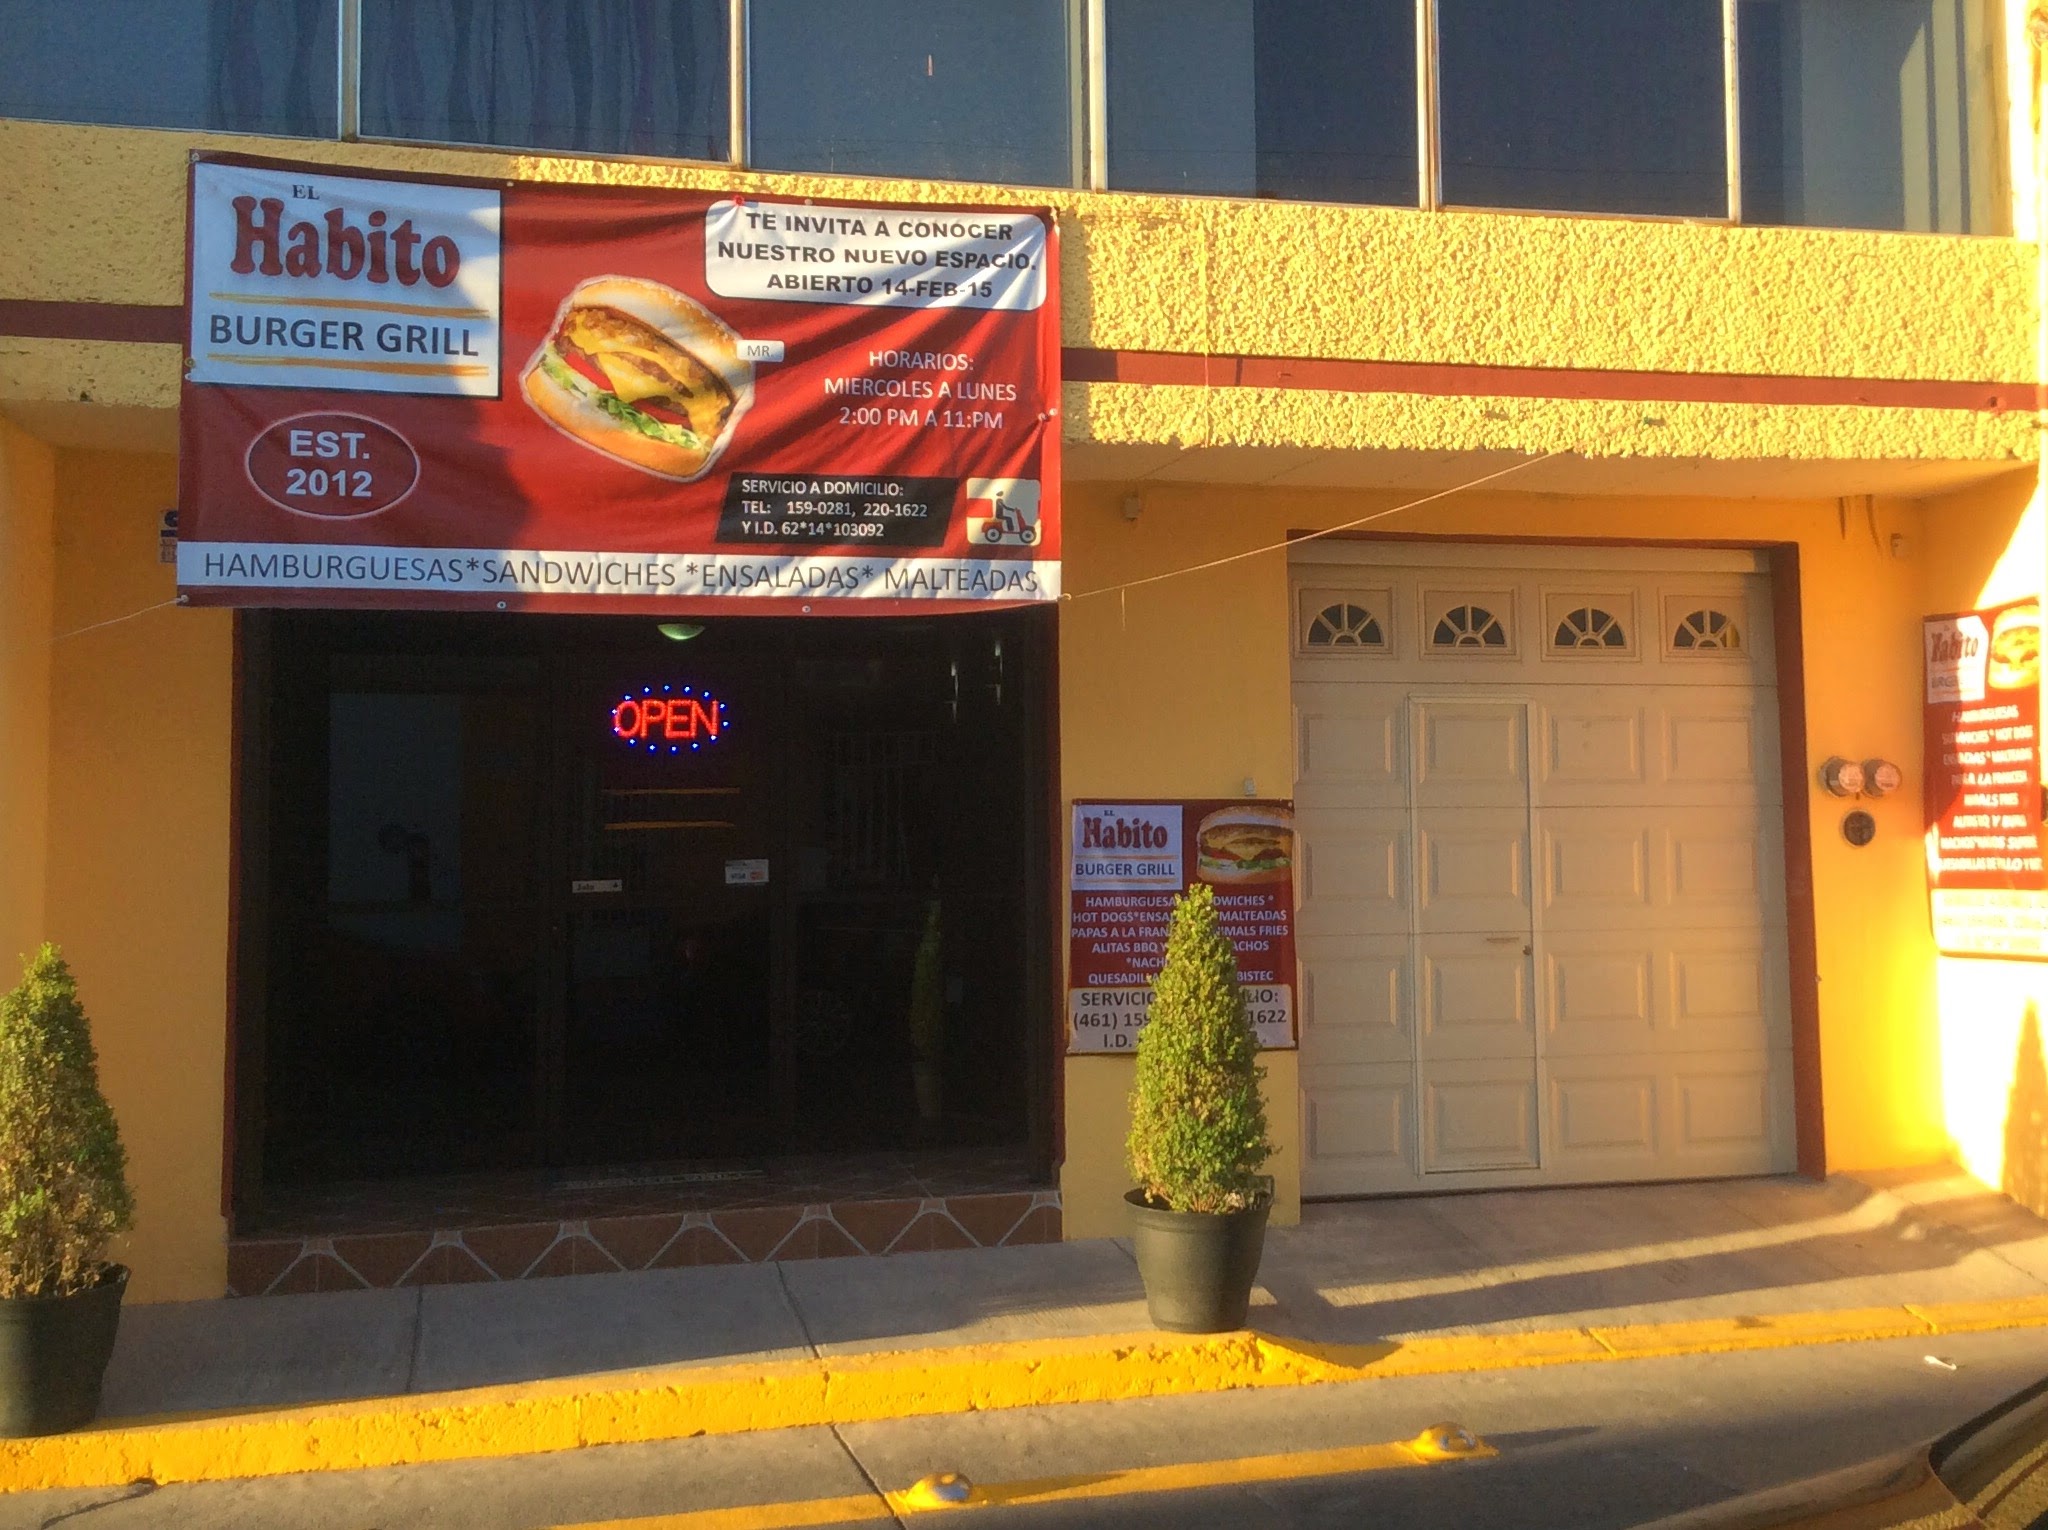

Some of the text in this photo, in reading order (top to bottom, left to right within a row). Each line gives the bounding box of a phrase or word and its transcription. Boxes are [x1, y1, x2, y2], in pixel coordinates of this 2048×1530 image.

[293, 184, 320, 200] EL
[746, 212, 1013, 241] TE INVITA A CONOCER
[230, 195, 461, 288] Habito
[717, 240, 1038, 271] NUESTRO NUEVO ESPACIO.
[766, 273, 993, 298] ABIERTO 14-FEB-15
[209, 314, 480, 357] BURGER GRILL
[746, 343, 773, 358] MR.
[869, 350, 974, 371] HORARIOS:
[824, 377, 1017, 402] MIERCOLES A LUNES
[839, 406, 1003, 429] 2:00 PM A 11:PM
[289, 429, 371, 460] EST.
[285, 468, 373, 498] 2012
[742, 479, 904, 497] SERVICIO A DOMICILIO:
[742, 500, 928, 518] TEL: 159-0281, 220-1622
[742, 521, 752, 536] Y
[755, 521, 778, 536] I.D.
[884, 568, 1039, 594] MALTEADAS
[613, 698, 720, 740] OPEN
[1082, 817, 1168, 849] Habito
[1075, 863, 1176, 876] BURGER GRILL
[1085, 895, 1266, 908] HAMBURGUESA DWICHES
[1072, 912, 1099, 923] HOT
[1071, 927, 1108, 938] PAPAS
[1110, 926, 1120, 938] A
[1121, 926, 1137, 938] LA
[1138, 926, 1168, 938] FRAN
[1259, 925, 1289, 936] FRIES
[1091, 942, 1131, 953] ALITAS
[1133, 942, 1159, 954] BBQ
[1073, 1012, 1118, 1031] (461)
[1247, 1009, 1287, 1024] 1622
[1103, 1033, 1133, 1048] I.D.
